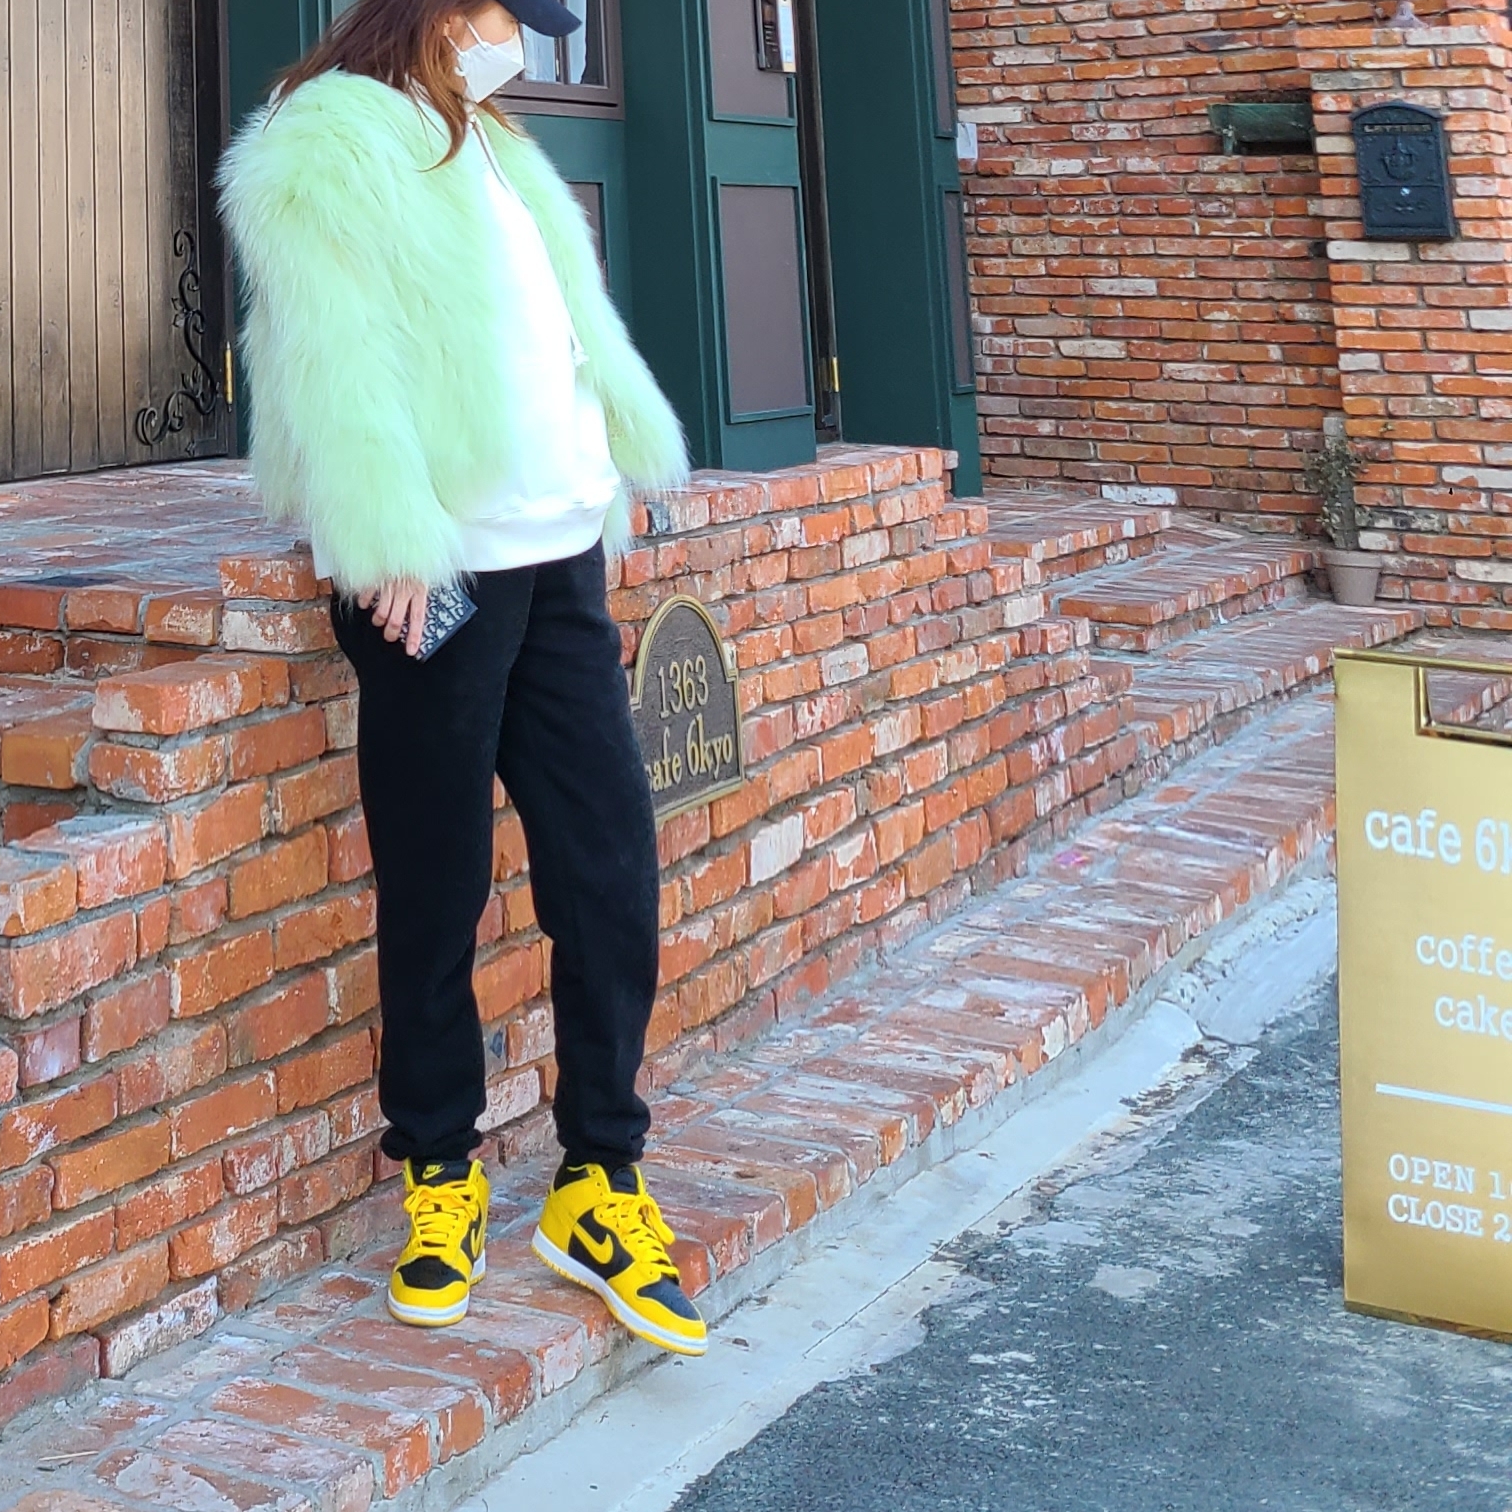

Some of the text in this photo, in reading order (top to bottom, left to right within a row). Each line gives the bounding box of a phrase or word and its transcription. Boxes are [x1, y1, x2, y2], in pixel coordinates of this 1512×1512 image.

[658, 654, 709, 718] 1363
[686, 713, 733, 780] 6kyo
[1364, 807, 1462, 865] cafe
[1415, 933, 1512, 981] coffe
[1388, 1153, 1512, 1200] OPEN 1
[1387, 1194, 1485, 1238] CLOSE
